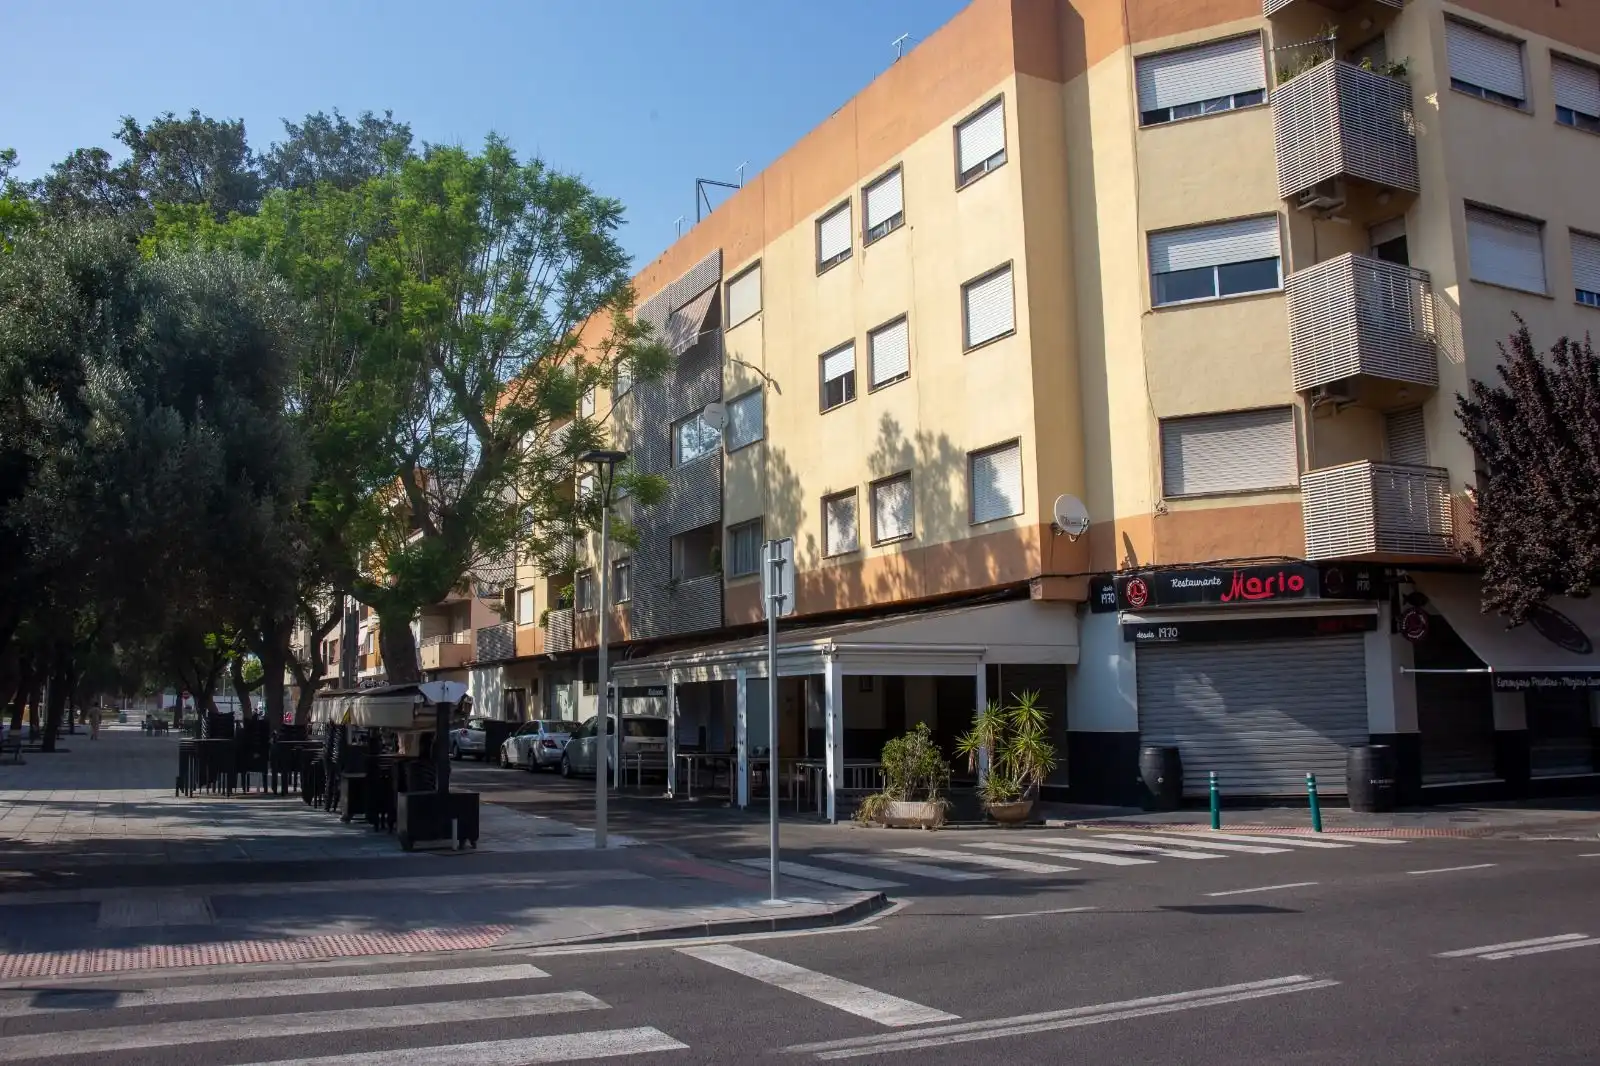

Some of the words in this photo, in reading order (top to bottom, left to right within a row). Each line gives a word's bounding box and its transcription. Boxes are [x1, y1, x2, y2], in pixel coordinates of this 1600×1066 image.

[1170, 575, 1222, 588] Restaurante
[1220, 568, 1305, 602] Mario
[1101, 592, 1115, 604] 1970
[1136, 629, 1155, 638] desde
[1158, 627, 1178, 637] 1970
